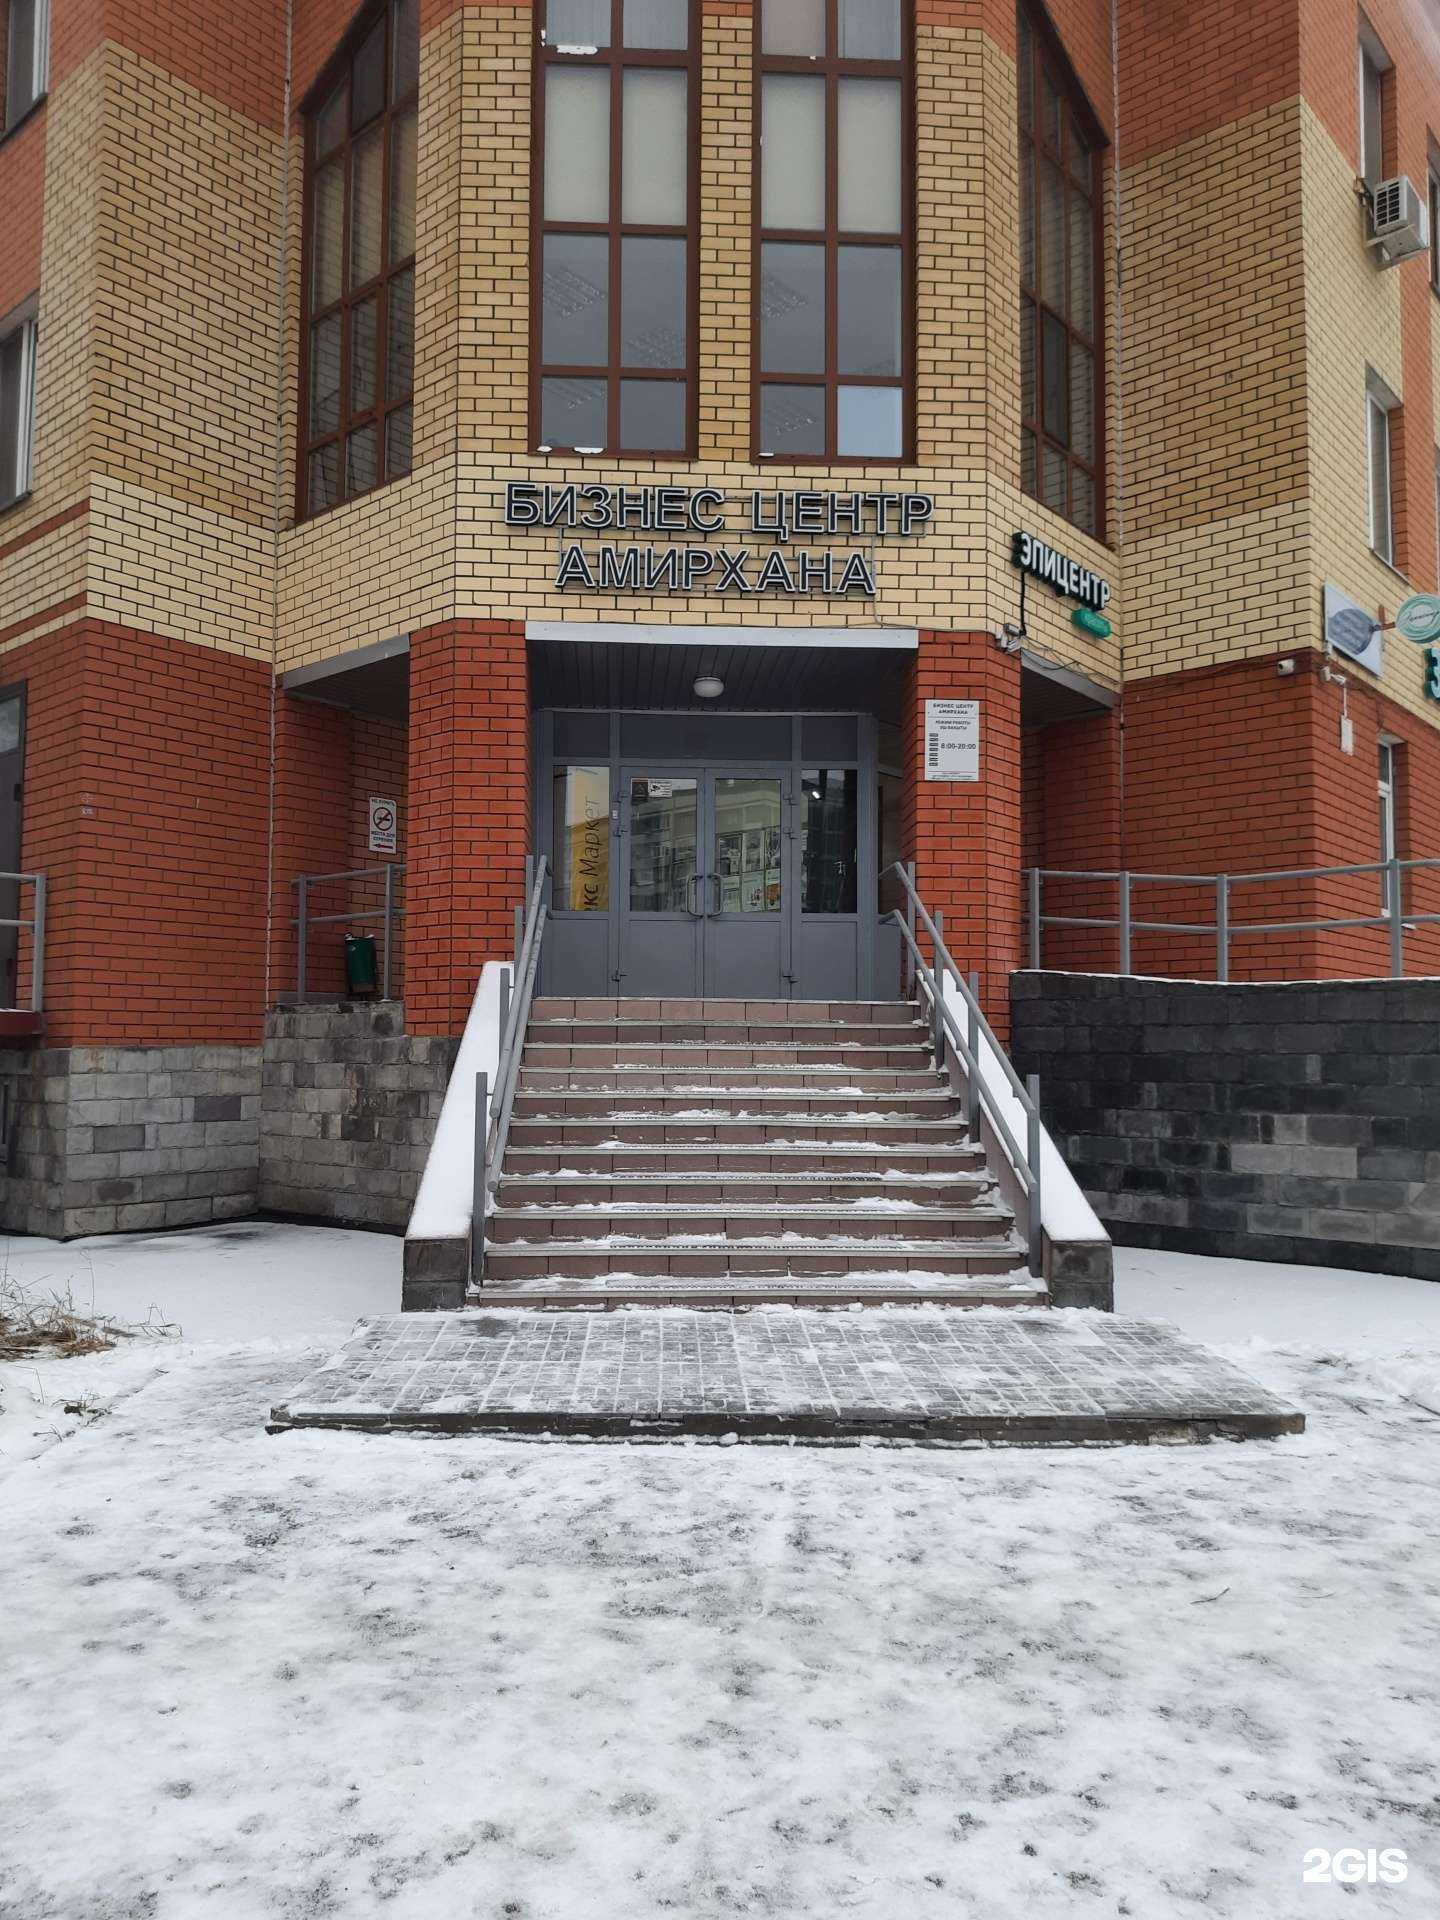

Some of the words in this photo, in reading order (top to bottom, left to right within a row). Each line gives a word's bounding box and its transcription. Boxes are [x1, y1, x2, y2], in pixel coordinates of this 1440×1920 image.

[505, 482, 727, 532] БИЗНЕС
[752, 490, 935, 542] ЦЕНТР
[555, 544, 877, 595] АМИРХАНА
[1018, 532, 1112, 610] ЭПИЦЕНТР
[940, 742, 977, 750] 8:00-20:00
[578, 795, 602, 878] Маркет
[583, 883, 599, 912] кс
